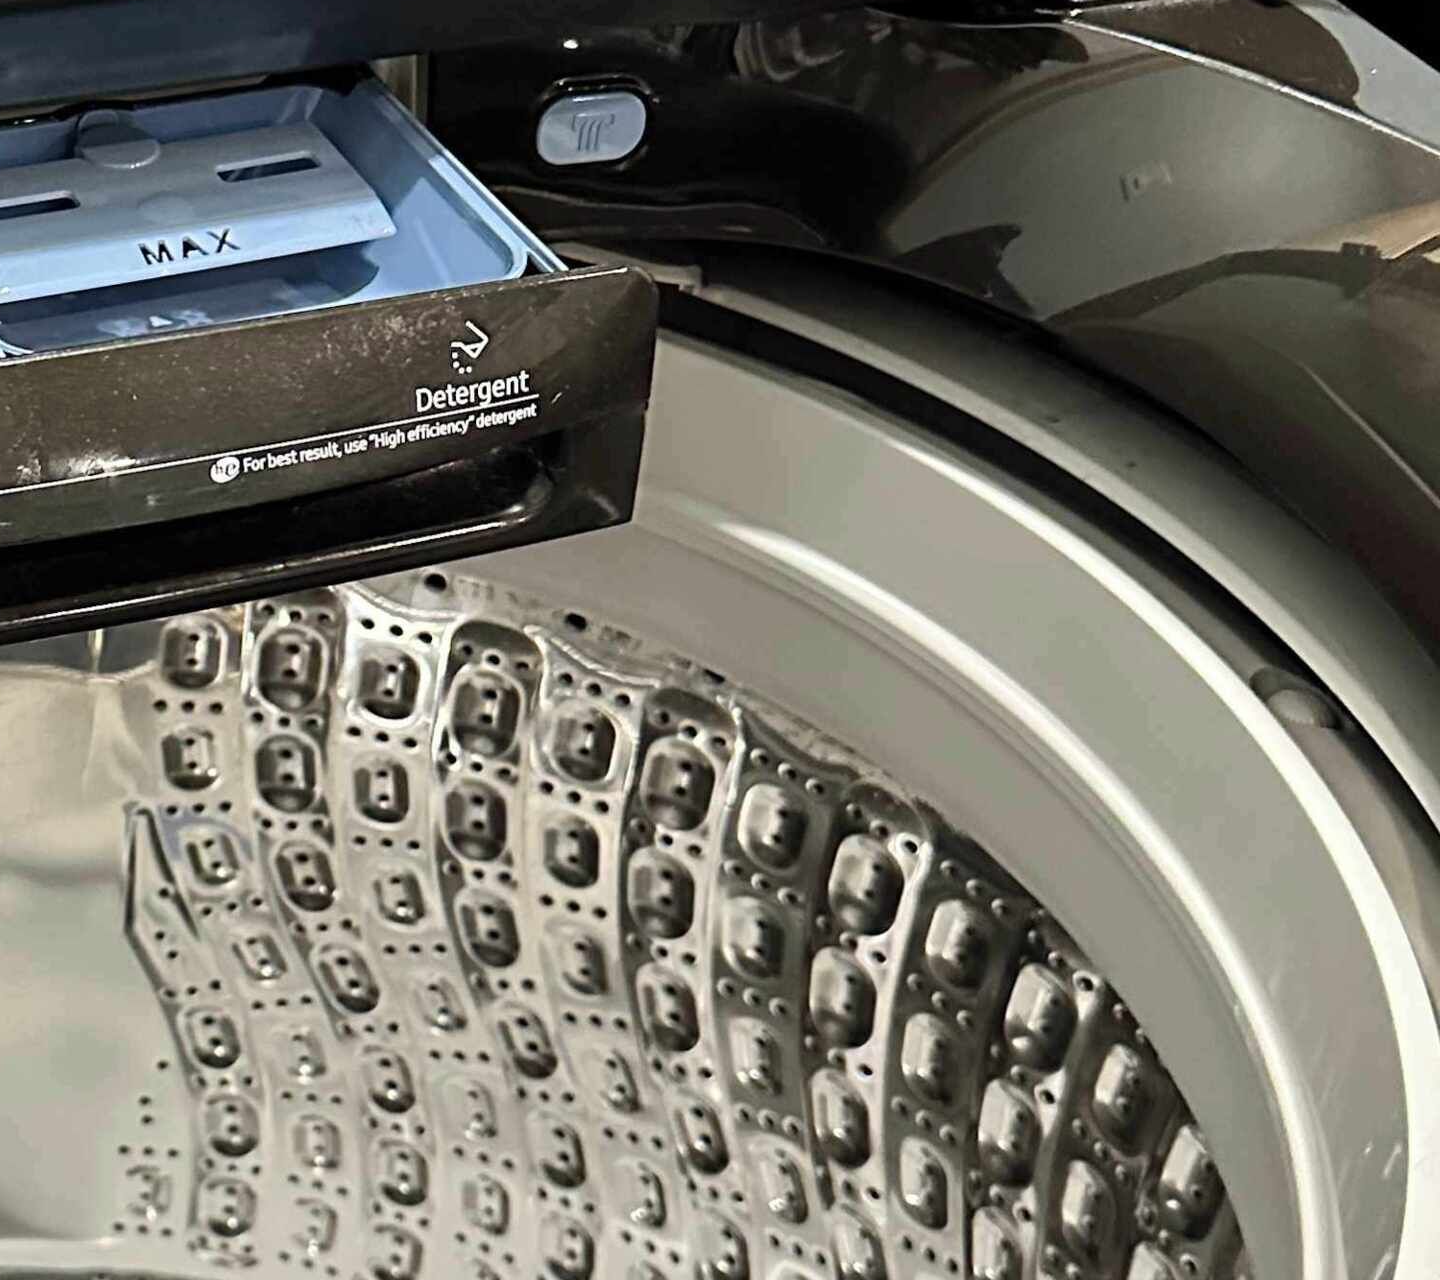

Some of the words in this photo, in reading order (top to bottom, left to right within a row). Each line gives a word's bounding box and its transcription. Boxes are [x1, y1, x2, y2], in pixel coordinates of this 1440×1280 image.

[139, 227, 241, 267] MAX
[415, 370, 530, 413] Detergent
[242, 456, 268, 473] For
[268, 449, 298, 468] best
[300, 443, 342, 463] result,
[343, 437, 368, 454] use
[475, 402, 537, 430] detergent
